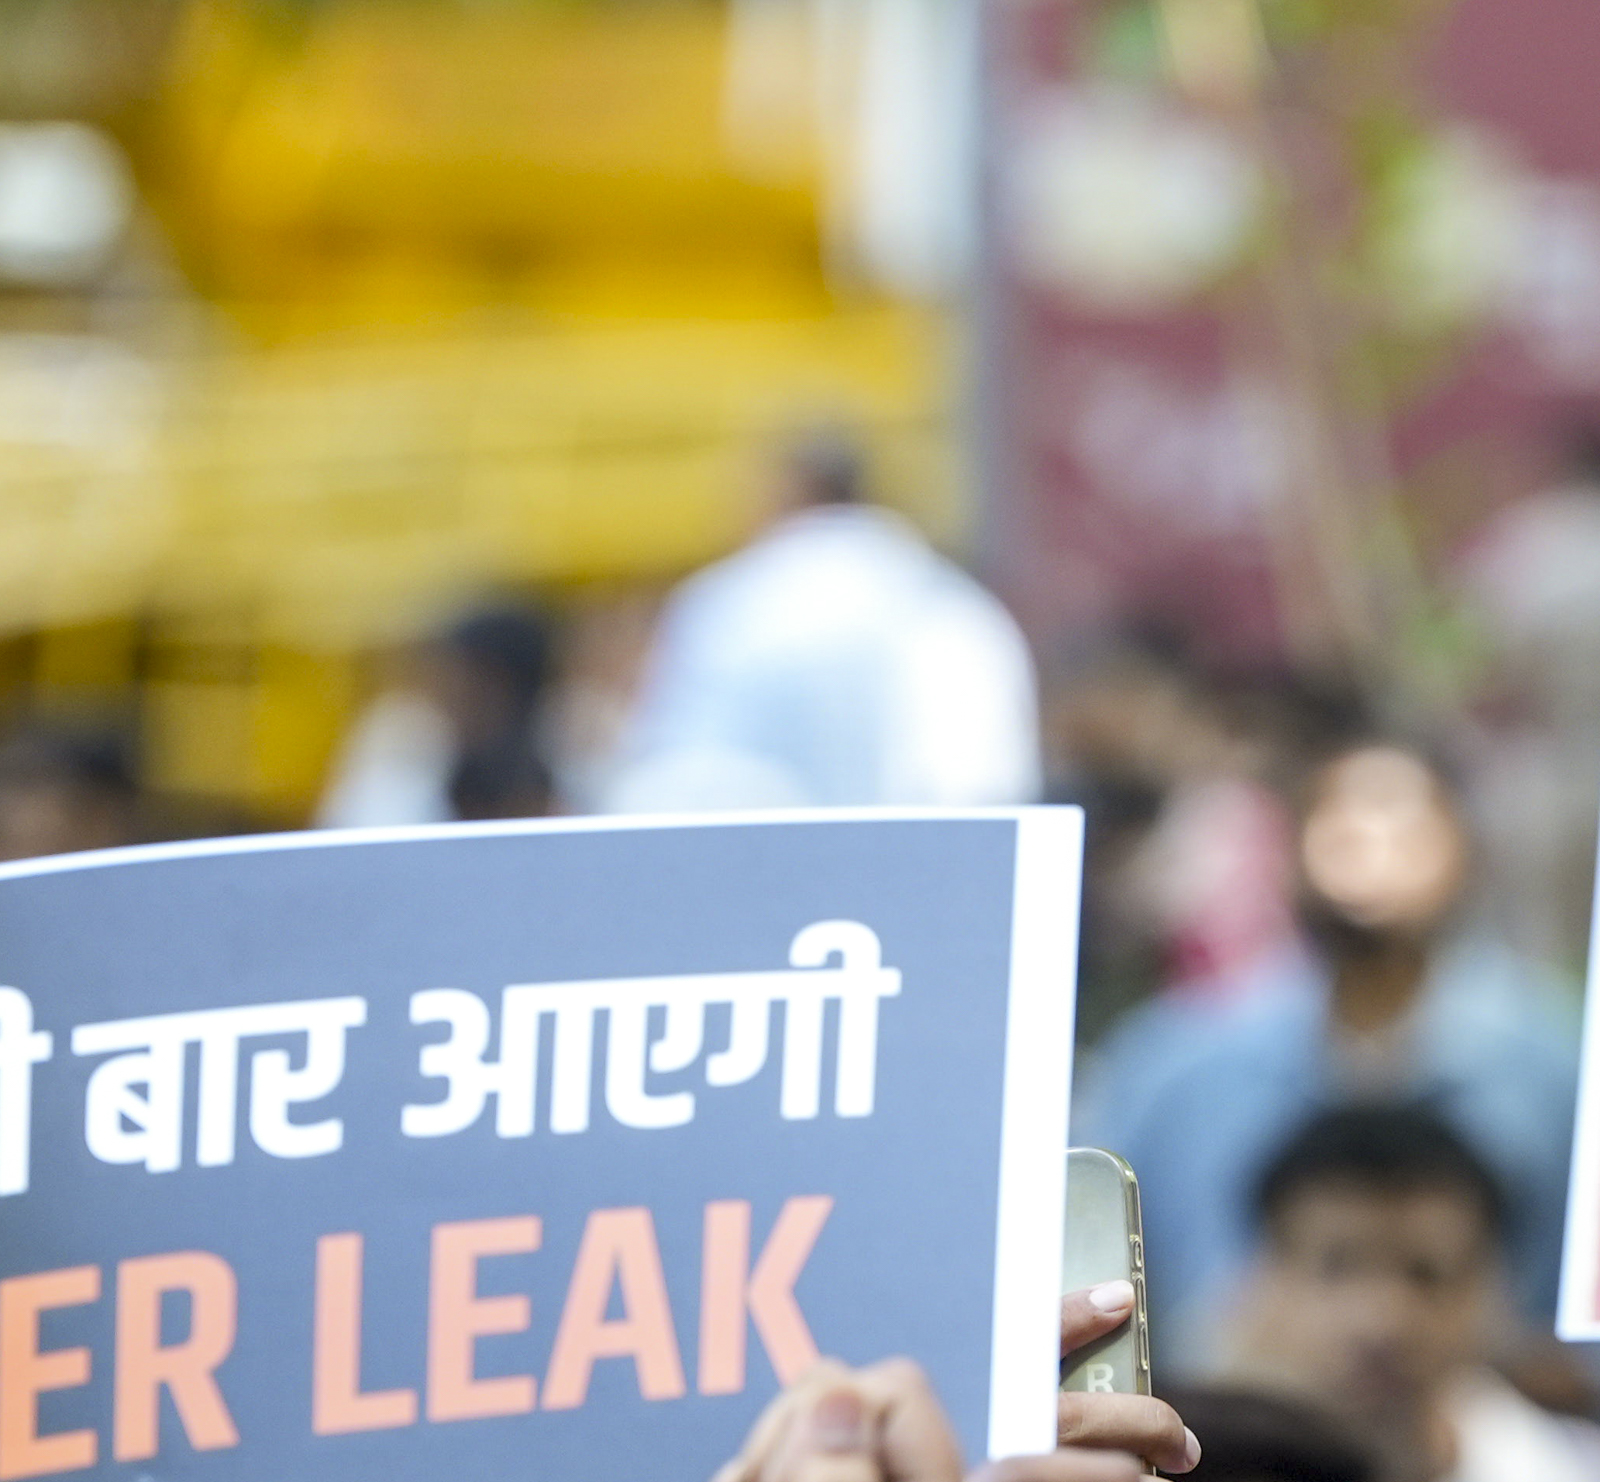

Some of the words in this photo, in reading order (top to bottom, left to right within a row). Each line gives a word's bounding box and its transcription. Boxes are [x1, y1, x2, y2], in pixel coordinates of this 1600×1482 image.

[71, 996, 367, 1173] बार
[401, 919, 903, 1139] आएगी
[312, 1195, 834, 1436] LEAK
